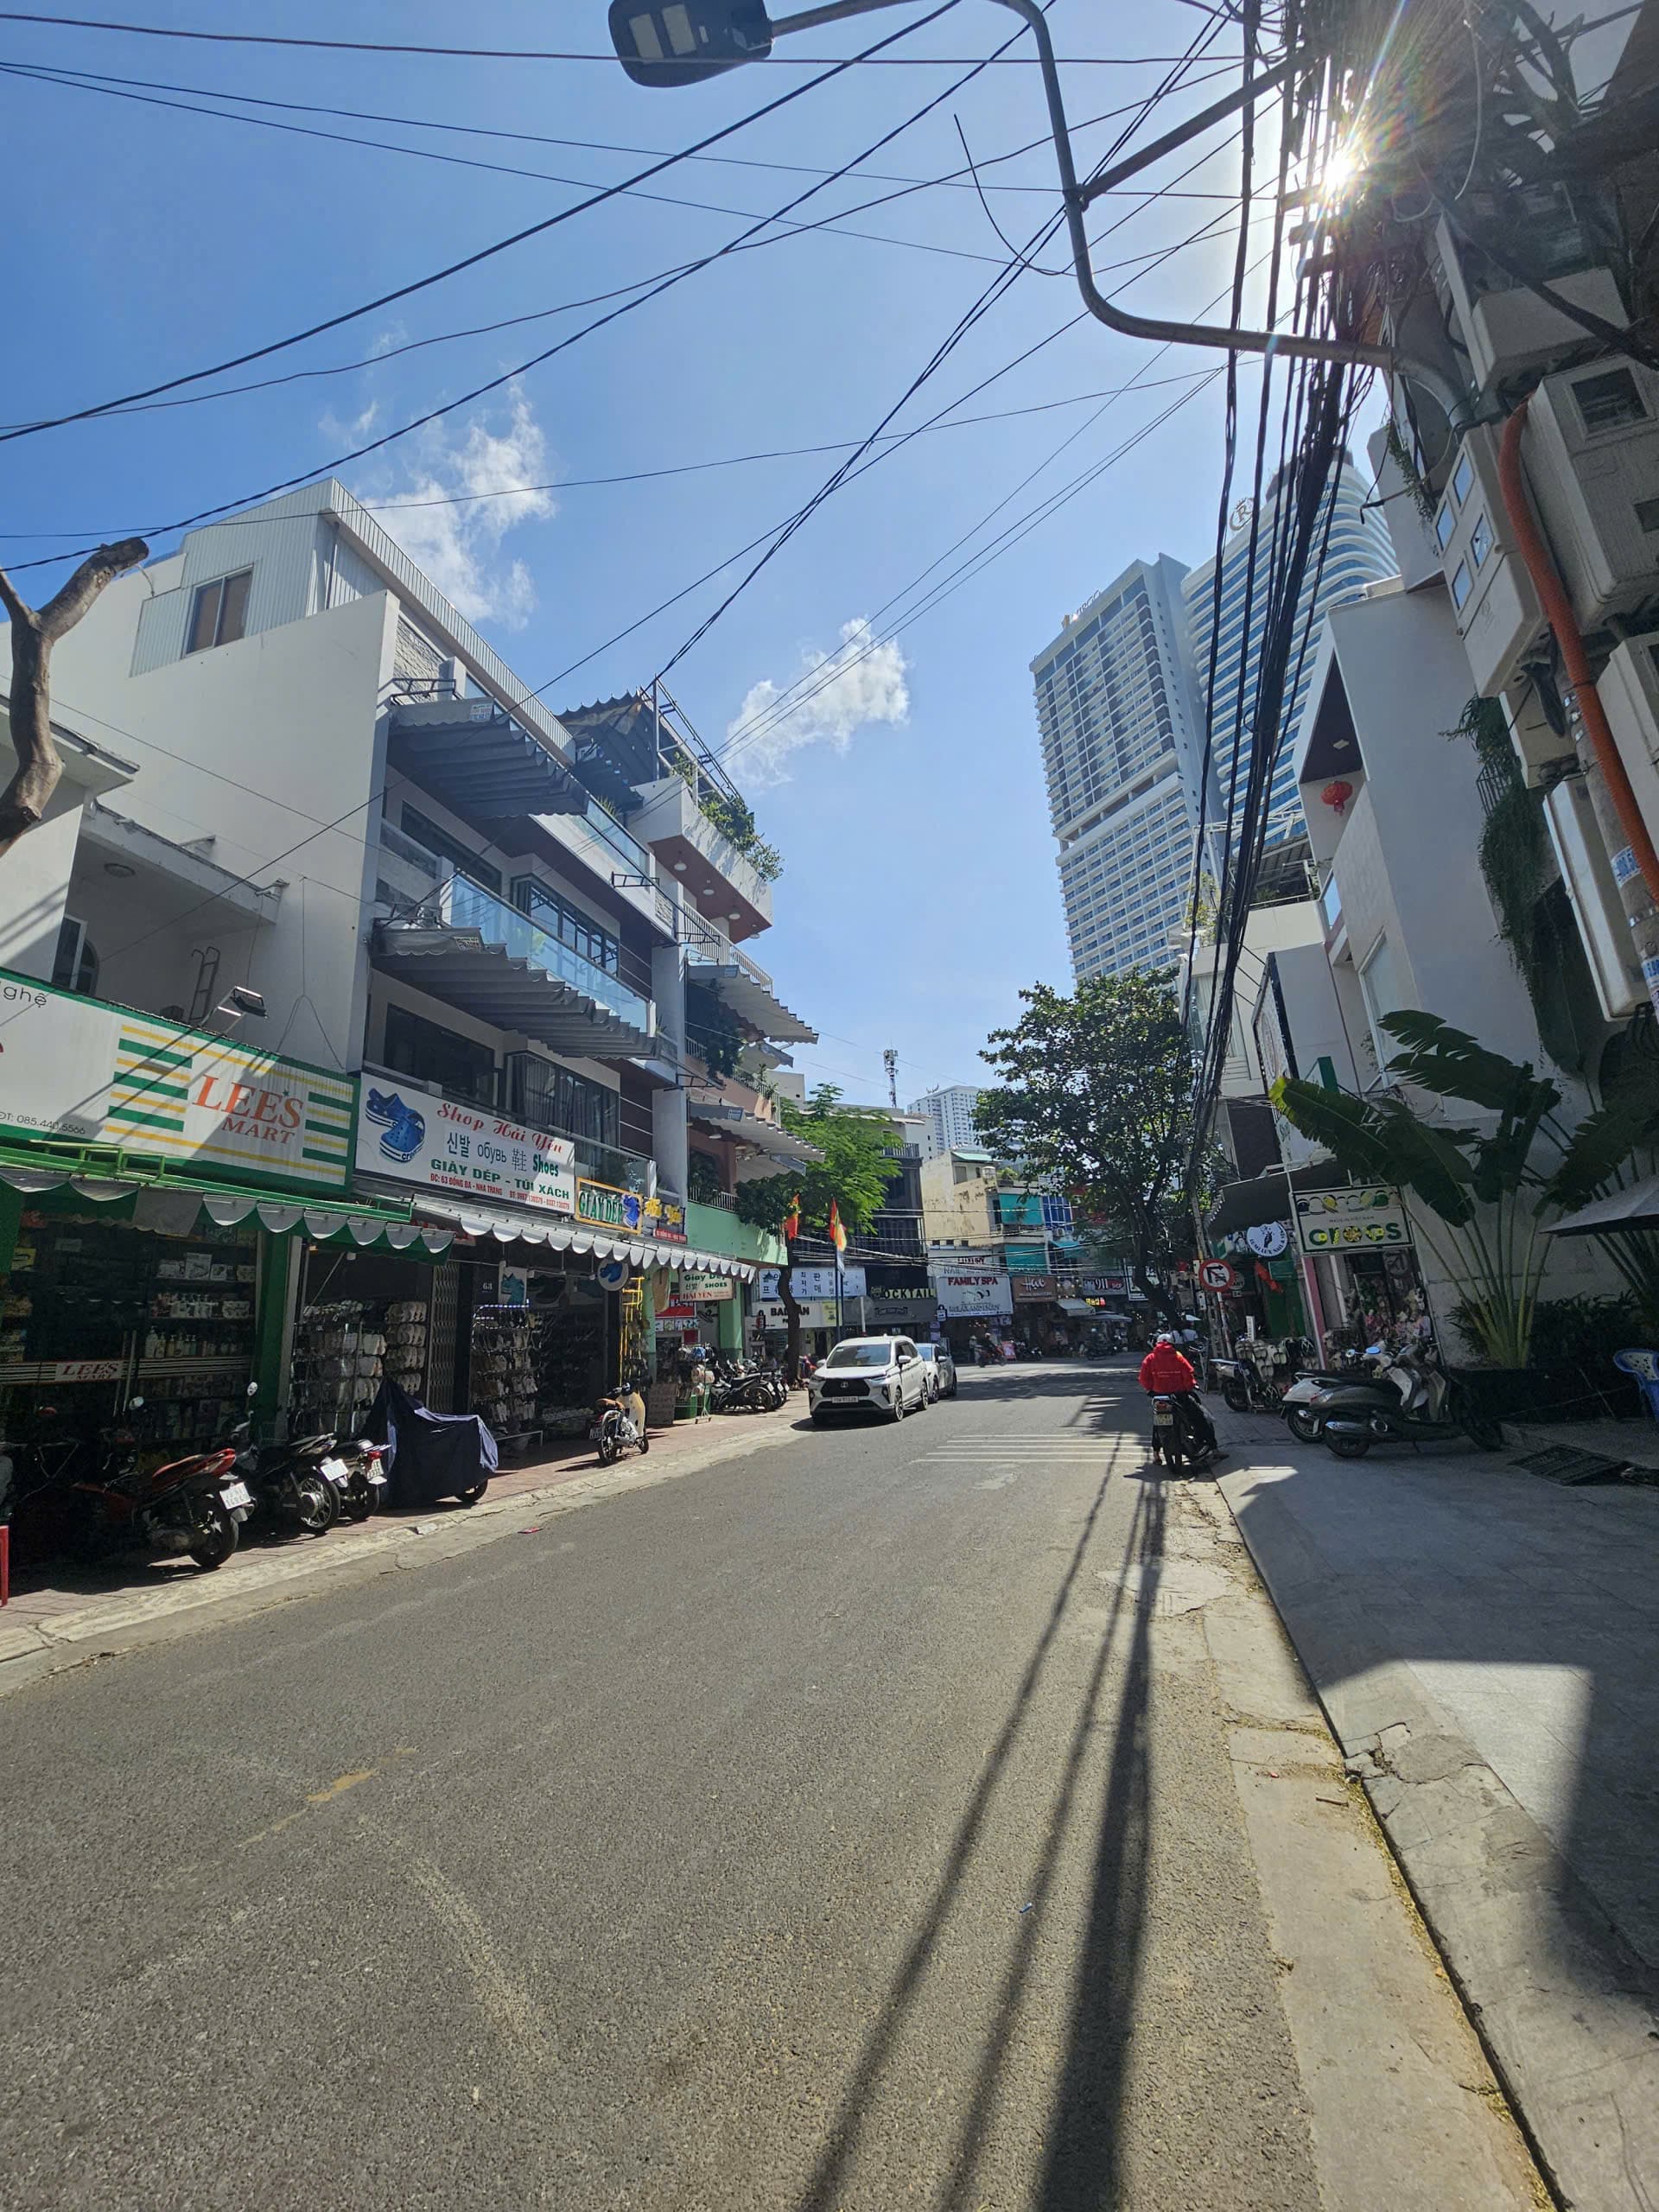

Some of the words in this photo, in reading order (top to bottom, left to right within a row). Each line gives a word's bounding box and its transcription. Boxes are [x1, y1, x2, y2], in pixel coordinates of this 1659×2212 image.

[0, 982, 47, 1007] ghệ
[437, 1102, 484, 1131] Shop
[222, 1118, 296, 1144] MART
[447, 1132, 471, 1158] 신발
[477, 1141, 507, 1164] обувь
[533, 1154, 559, 1177] Shoes
[948, 1277, 980, 1286] FAMILY
[982, 1276, 999, 1285] SPA
[876, 1288, 934, 1299] OCKTAIL
